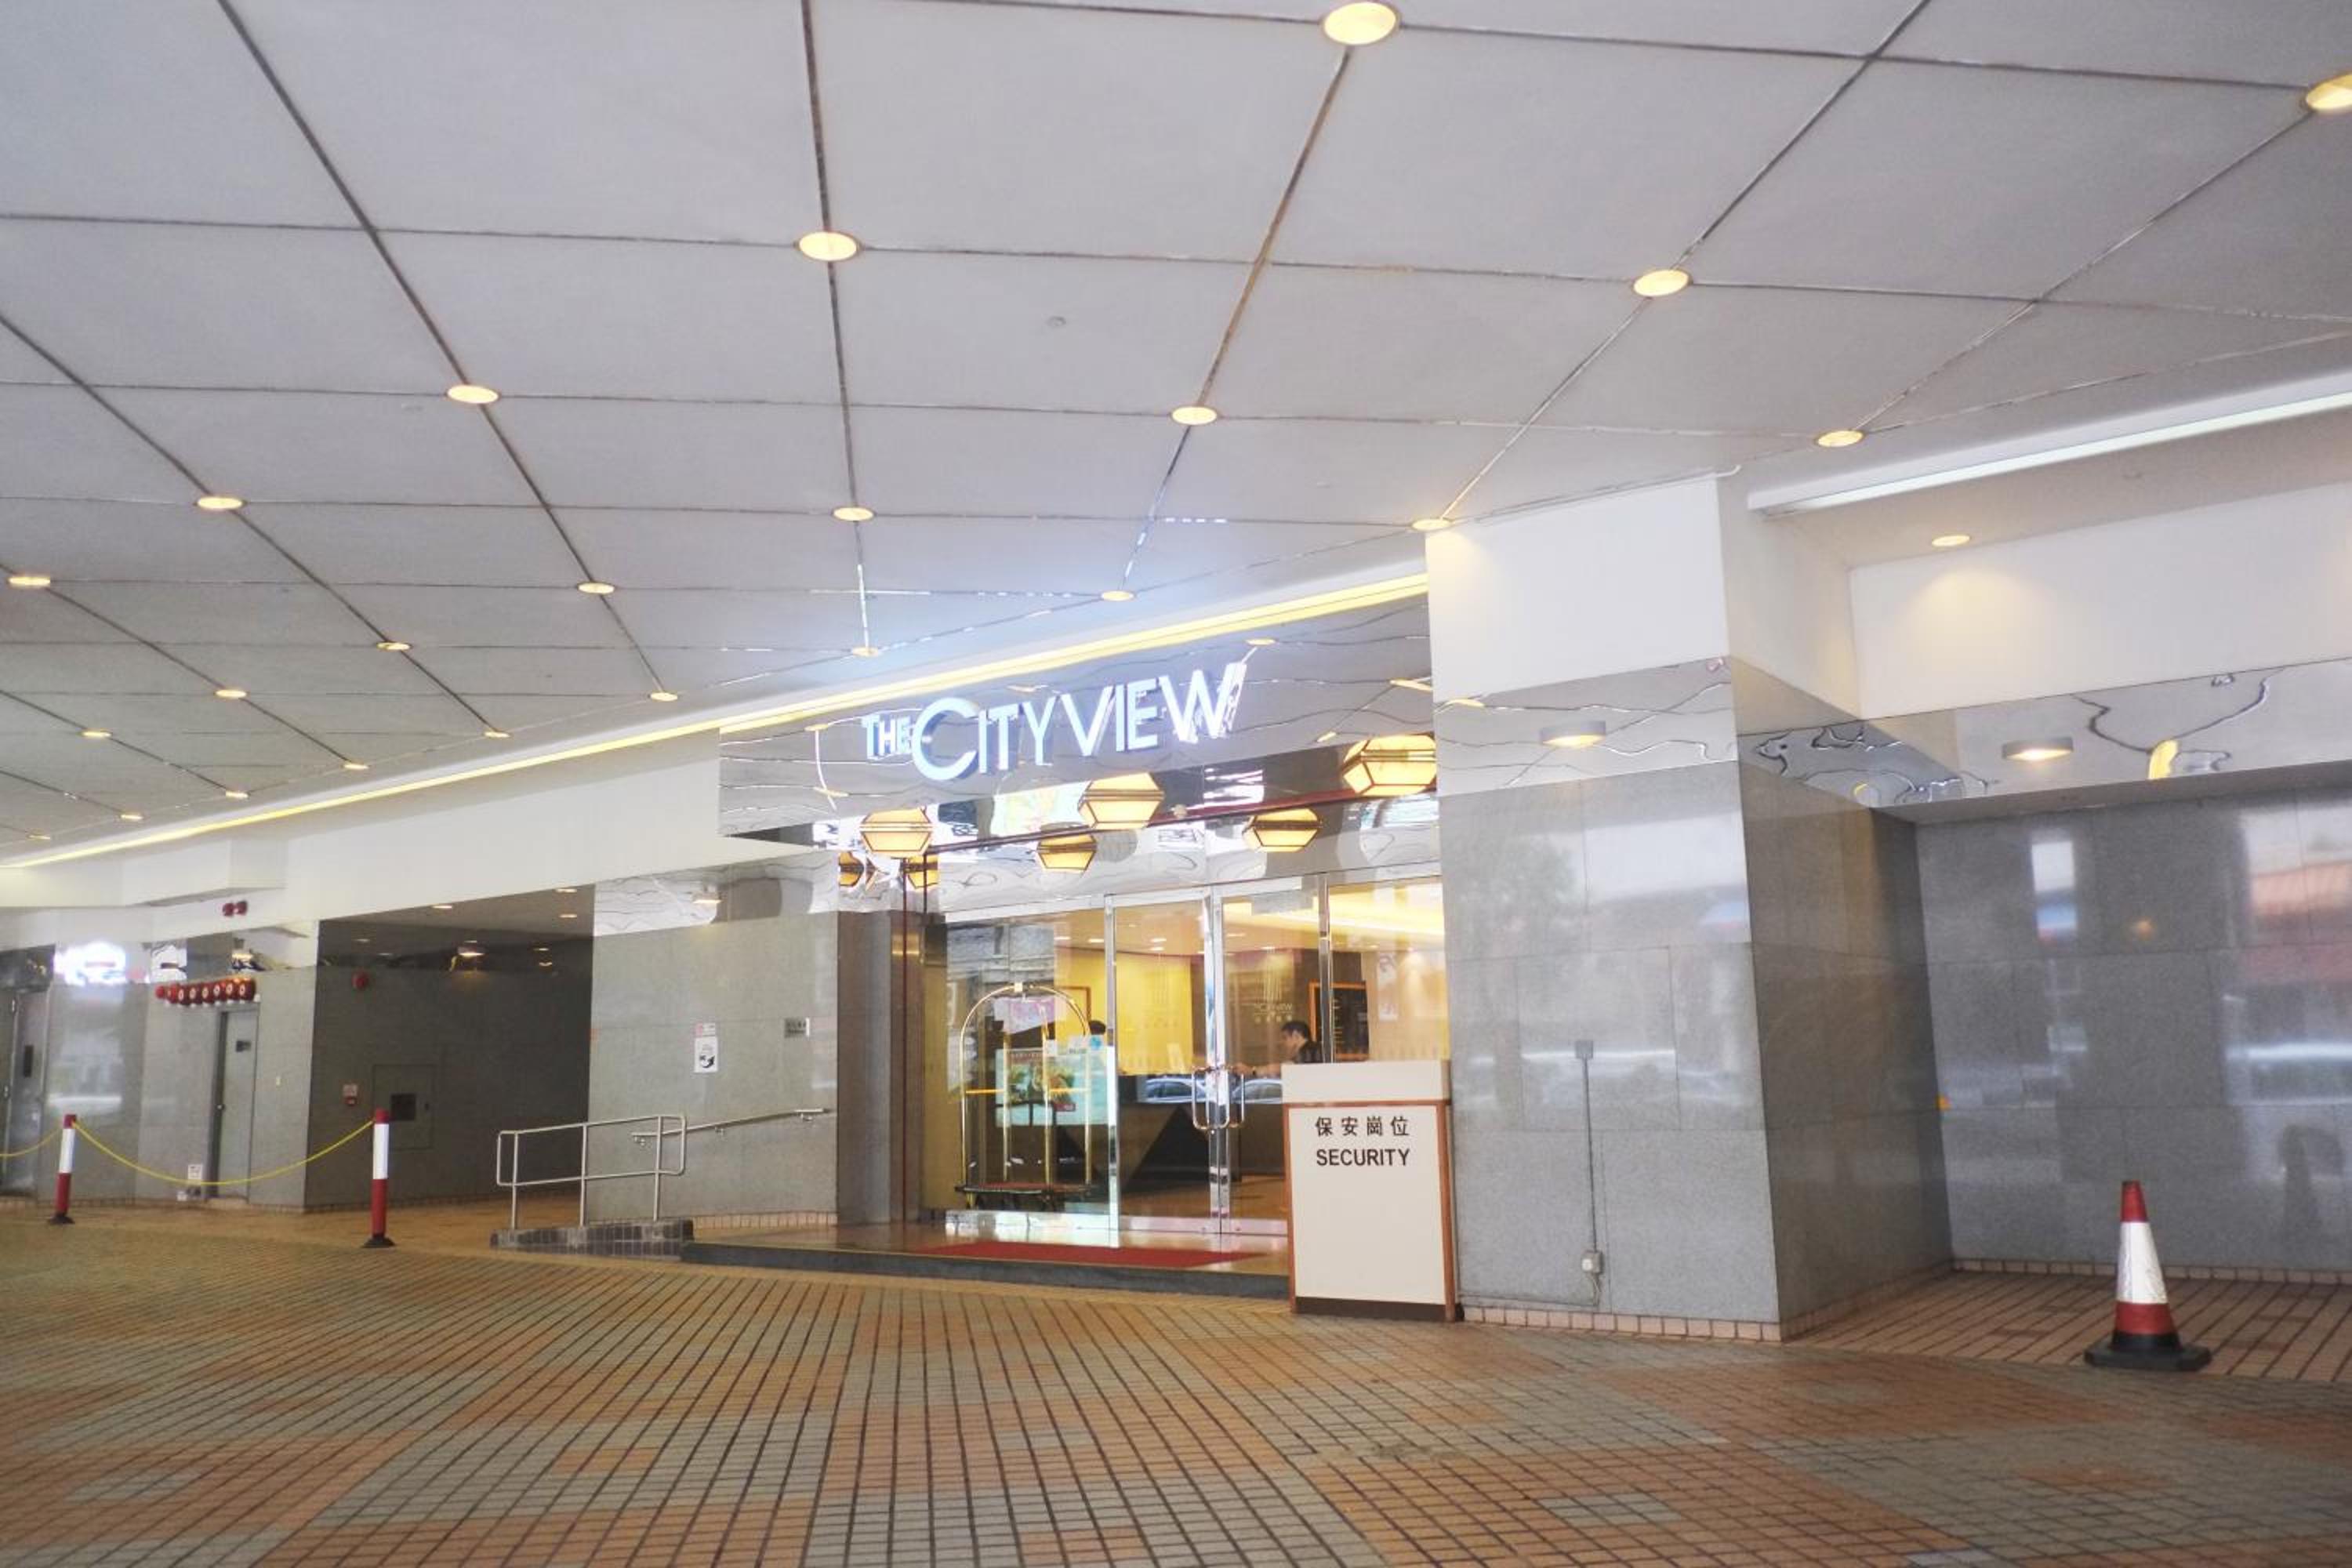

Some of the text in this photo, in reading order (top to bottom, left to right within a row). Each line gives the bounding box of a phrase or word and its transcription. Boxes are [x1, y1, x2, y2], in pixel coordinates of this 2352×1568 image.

[862, 662, 1247, 781] THE CITYVIEW
[1315, 1115, 1410, 1137] 保安崗位
[1316, 1149, 1410, 1167] SECURITY
